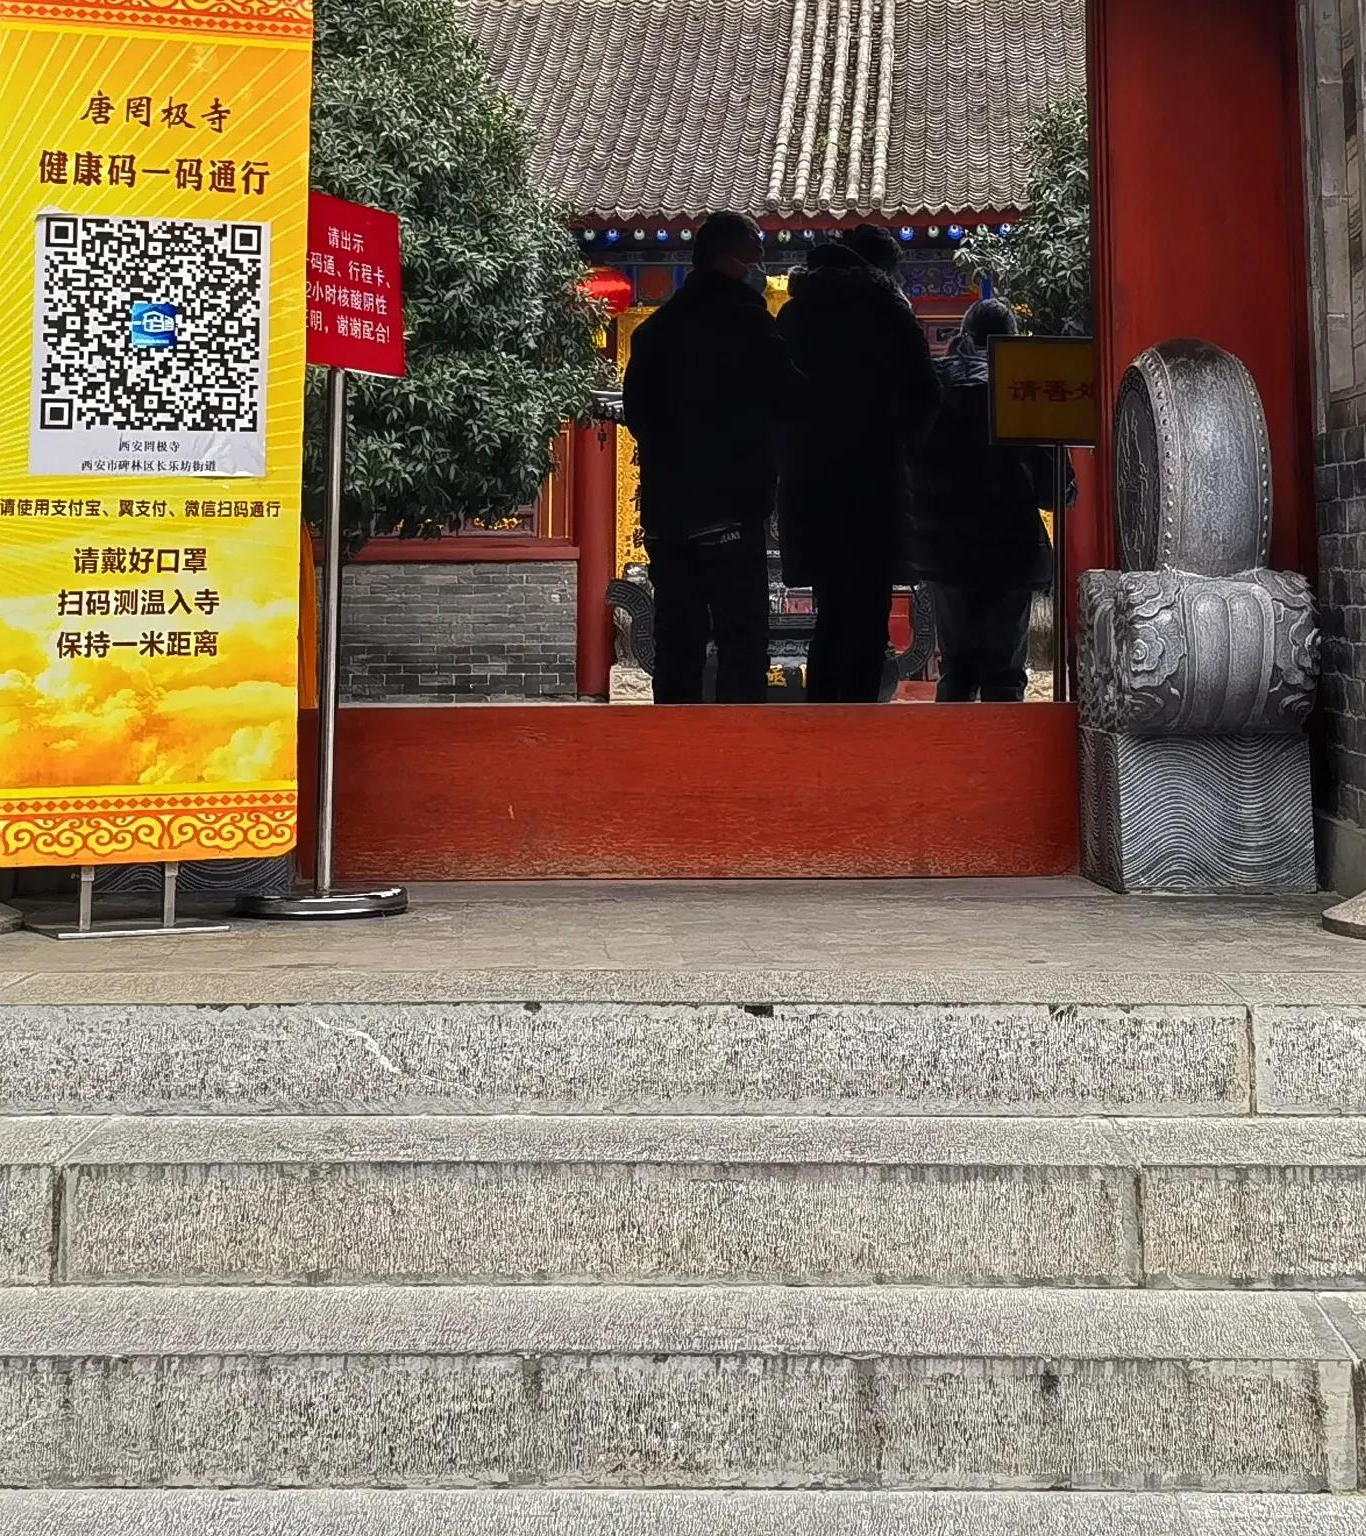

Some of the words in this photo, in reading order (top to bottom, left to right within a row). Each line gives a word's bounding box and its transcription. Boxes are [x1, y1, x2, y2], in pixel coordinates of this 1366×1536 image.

[79, 89, 232, 133] 唐罔极寺
[37, 149, 272, 196] 健康码一码通行
[327, 226, 364, 254] 请出示
[81, 459, 217, 473] 西安市碑林区长乐坊街道
[0, 498, 281, 519] 请使用支付宝、翼支付、微信扫码通行
[73, 546, 208, 576] 请戴好口罩
[57, 589, 220, 617] 扫码测温入寺
[56, 630, 219, 659] 保持一米距离
